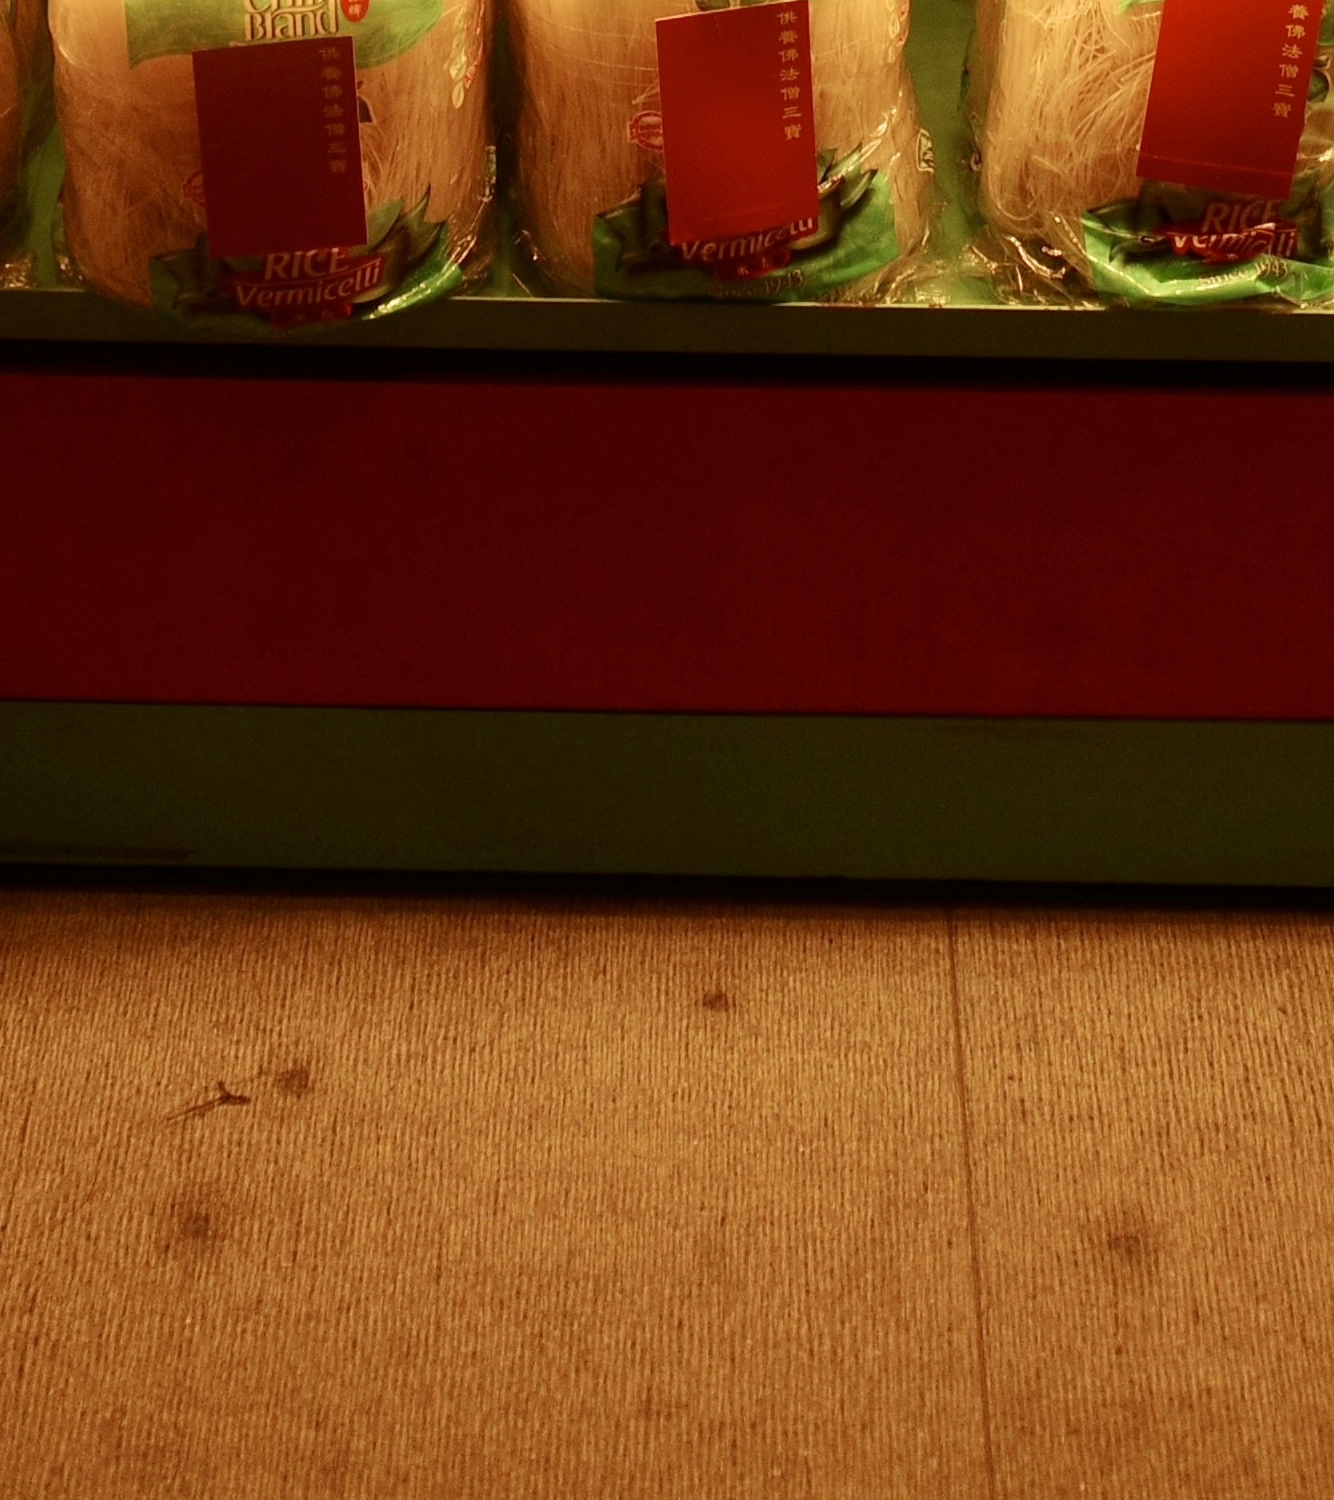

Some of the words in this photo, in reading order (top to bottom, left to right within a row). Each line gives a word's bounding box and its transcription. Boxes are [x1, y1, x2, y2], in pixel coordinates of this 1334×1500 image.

[1201, 200, 1282, 234] RICE
[263, 247, 349, 282] RICE
[234, 266, 382, 309] Vermicelli
